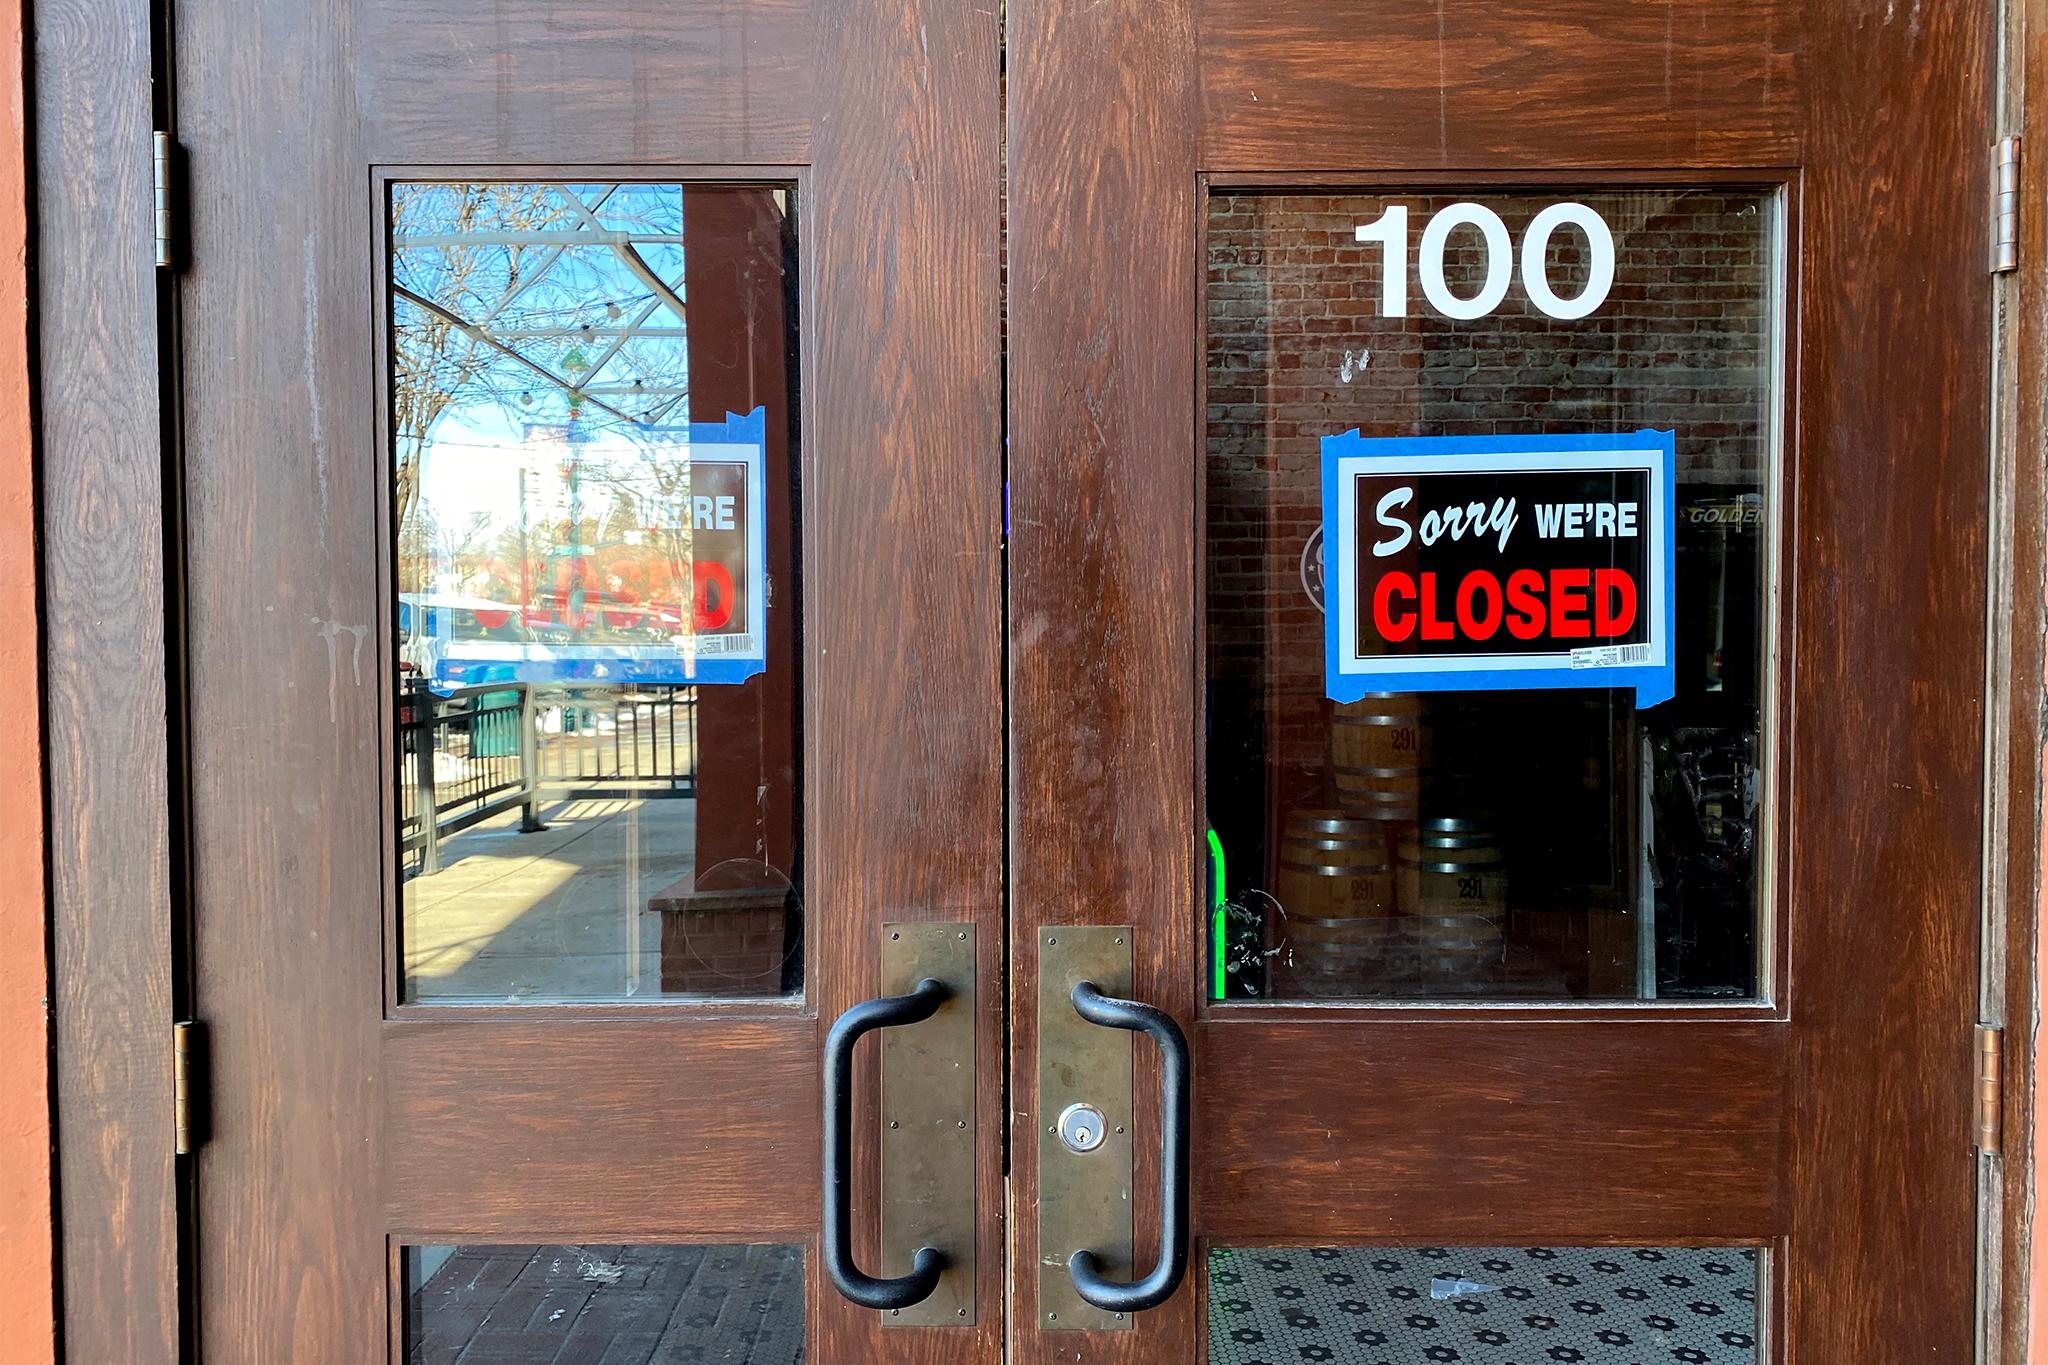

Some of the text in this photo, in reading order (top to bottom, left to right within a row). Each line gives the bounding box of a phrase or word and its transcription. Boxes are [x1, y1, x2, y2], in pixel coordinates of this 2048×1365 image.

[1354, 202, 1616, 320] 100
[1372, 486, 1638, 557] Sorry WE'RE
[1373, 568, 1637, 642] CLOSED
